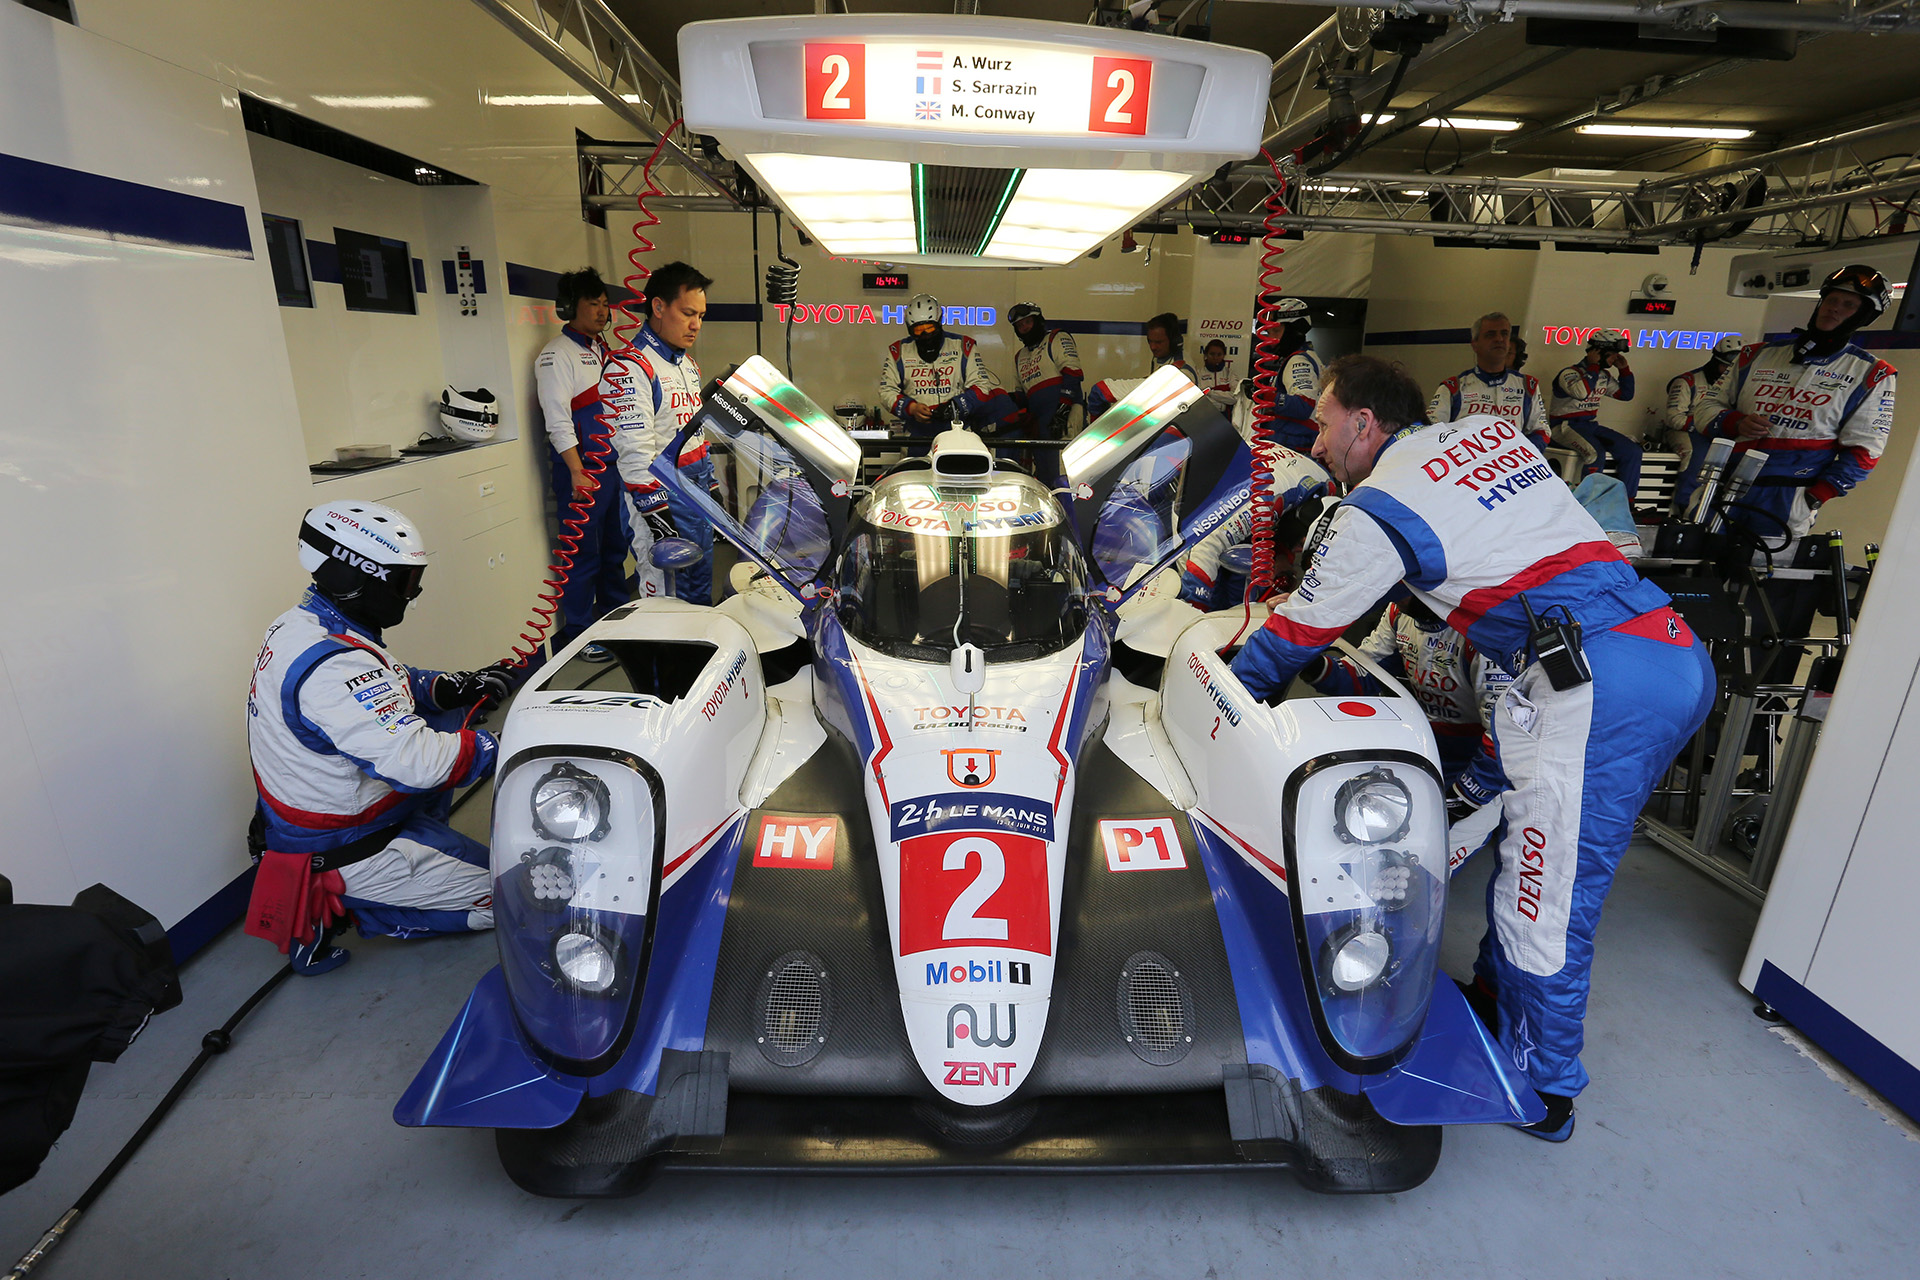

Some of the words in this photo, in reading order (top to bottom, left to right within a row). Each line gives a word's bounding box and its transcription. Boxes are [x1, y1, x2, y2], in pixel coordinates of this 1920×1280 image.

[953, 56, 966, 69] A.
[972, 56, 1012, 71] Wurz
[821, 54, 851, 110] 2
[952, 80, 966, 94] S.
[972, 81, 1037, 97] Sarrazin
[1104, 69, 1135, 124] 2
[951, 105, 969, 119] M.
[974, 105, 1035, 124] Conway
[774, 304, 877, 325] TOYOTA
[882, 305, 997, 326] HRID
[1201, 320, 1243, 330] DENSO
[911, 366, 954, 377] DENSO
[1815, 369, 1845, 381] Mobil
[1754, 384, 1832, 406] DENSO
[1468, 403, 1521, 416] DENSO
[1755, 401, 1813, 420] TOYOTA
[1768, 414, 1809, 430] BRID
[1421, 421, 1516, 482] DENSO
[1454, 446, 1539, 492] TOYOTA
[1477, 463, 1553, 511] HYBRID
[909, 500, 1017, 512] DENSO
[875, 509, 951, 531] TOYOTA
[963, 510, 1054, 532] HYBRID
[326, 511, 360, 529] TOYOTA
[360, 526, 400, 554] HYBRID
[331, 544, 391, 582] uvex
[344, 668, 384, 693] JTEKT
[701, 681, 729, 721] TOYOTA
[724, 649, 747, 688] HYBRID
[1405, 659, 1458, 692] ENSO
[360, 683, 390, 700] AISIN
[741, 677, 748, 699] 2
[1187, 652, 1210, 688] TOYOTA
[1206, 680, 1242, 727] HYBRID
[914, 706, 1026, 722] TOYOTA
[913, 721, 970, 731] GAZOO
[975, 721, 1027, 733] Racing
[1210, 716, 1220, 740] 2
[949, 805, 979, 819] LE
[982, 806, 1048, 826] MANS
[1032, 826, 1047, 834] 2015
[760, 824, 829, 860] HY
[1112, 826, 1171, 862] P1
[1517, 826, 1547, 922] DENSO
[942, 837, 1009, 941] 2
[926, 960, 1001, 985] Mobil
[944, 1061, 1016, 1086] ZENT
